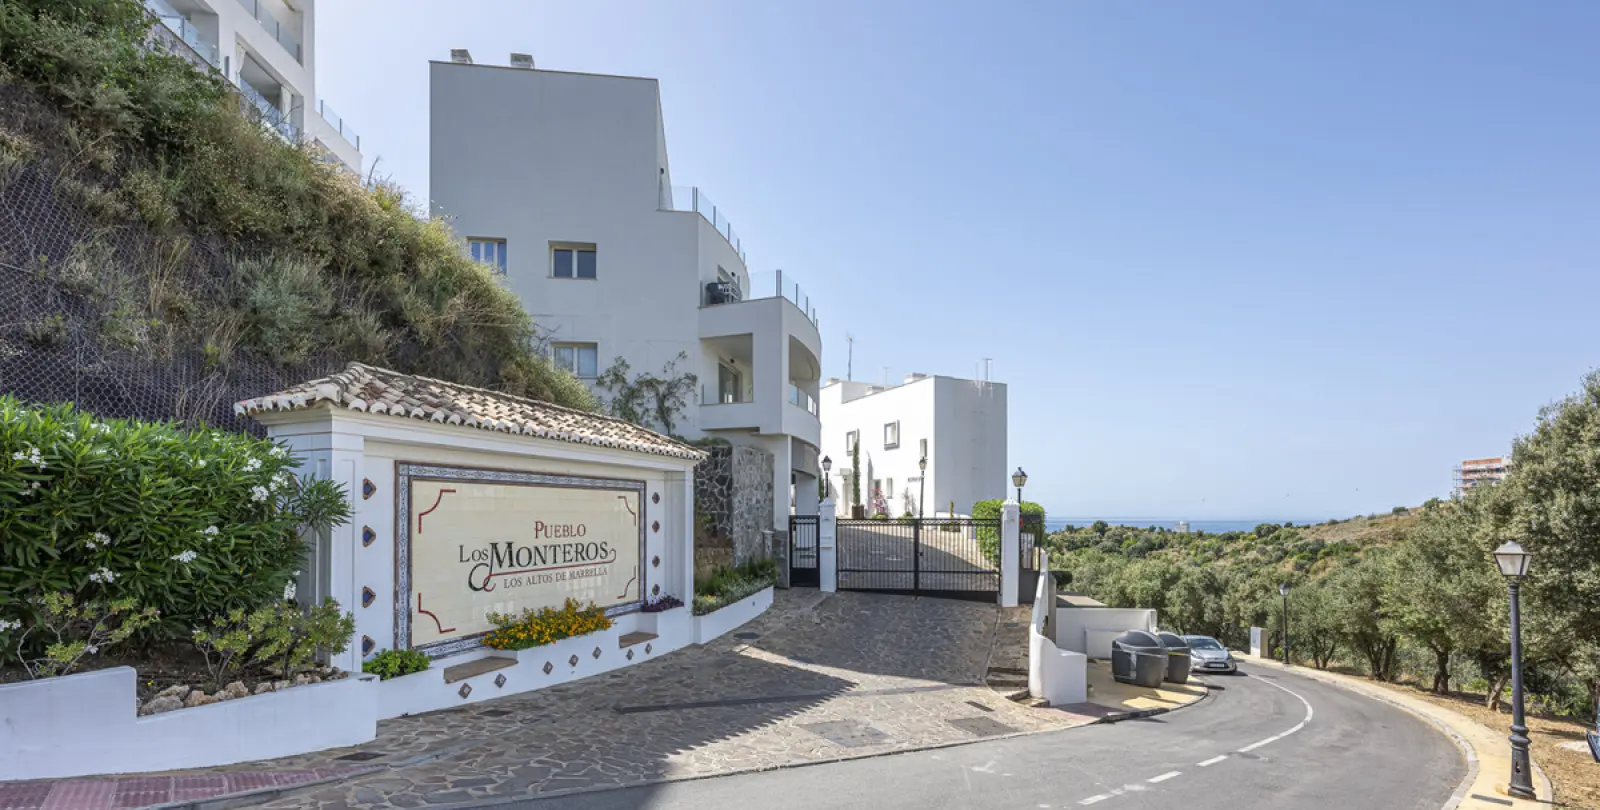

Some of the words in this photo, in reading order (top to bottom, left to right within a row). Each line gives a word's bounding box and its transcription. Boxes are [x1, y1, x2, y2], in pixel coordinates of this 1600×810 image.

[534, 520, 586, 539] PUEBLO
[459, 544, 489, 563] LOS
[489, 541, 609, 569] MONTEROS
[503, 578, 522, 589] LOS
[526, 574, 553, 586] ALTOS
[555, 572, 567, 582] DE
[569, 566, 608, 580] MARBELLA
